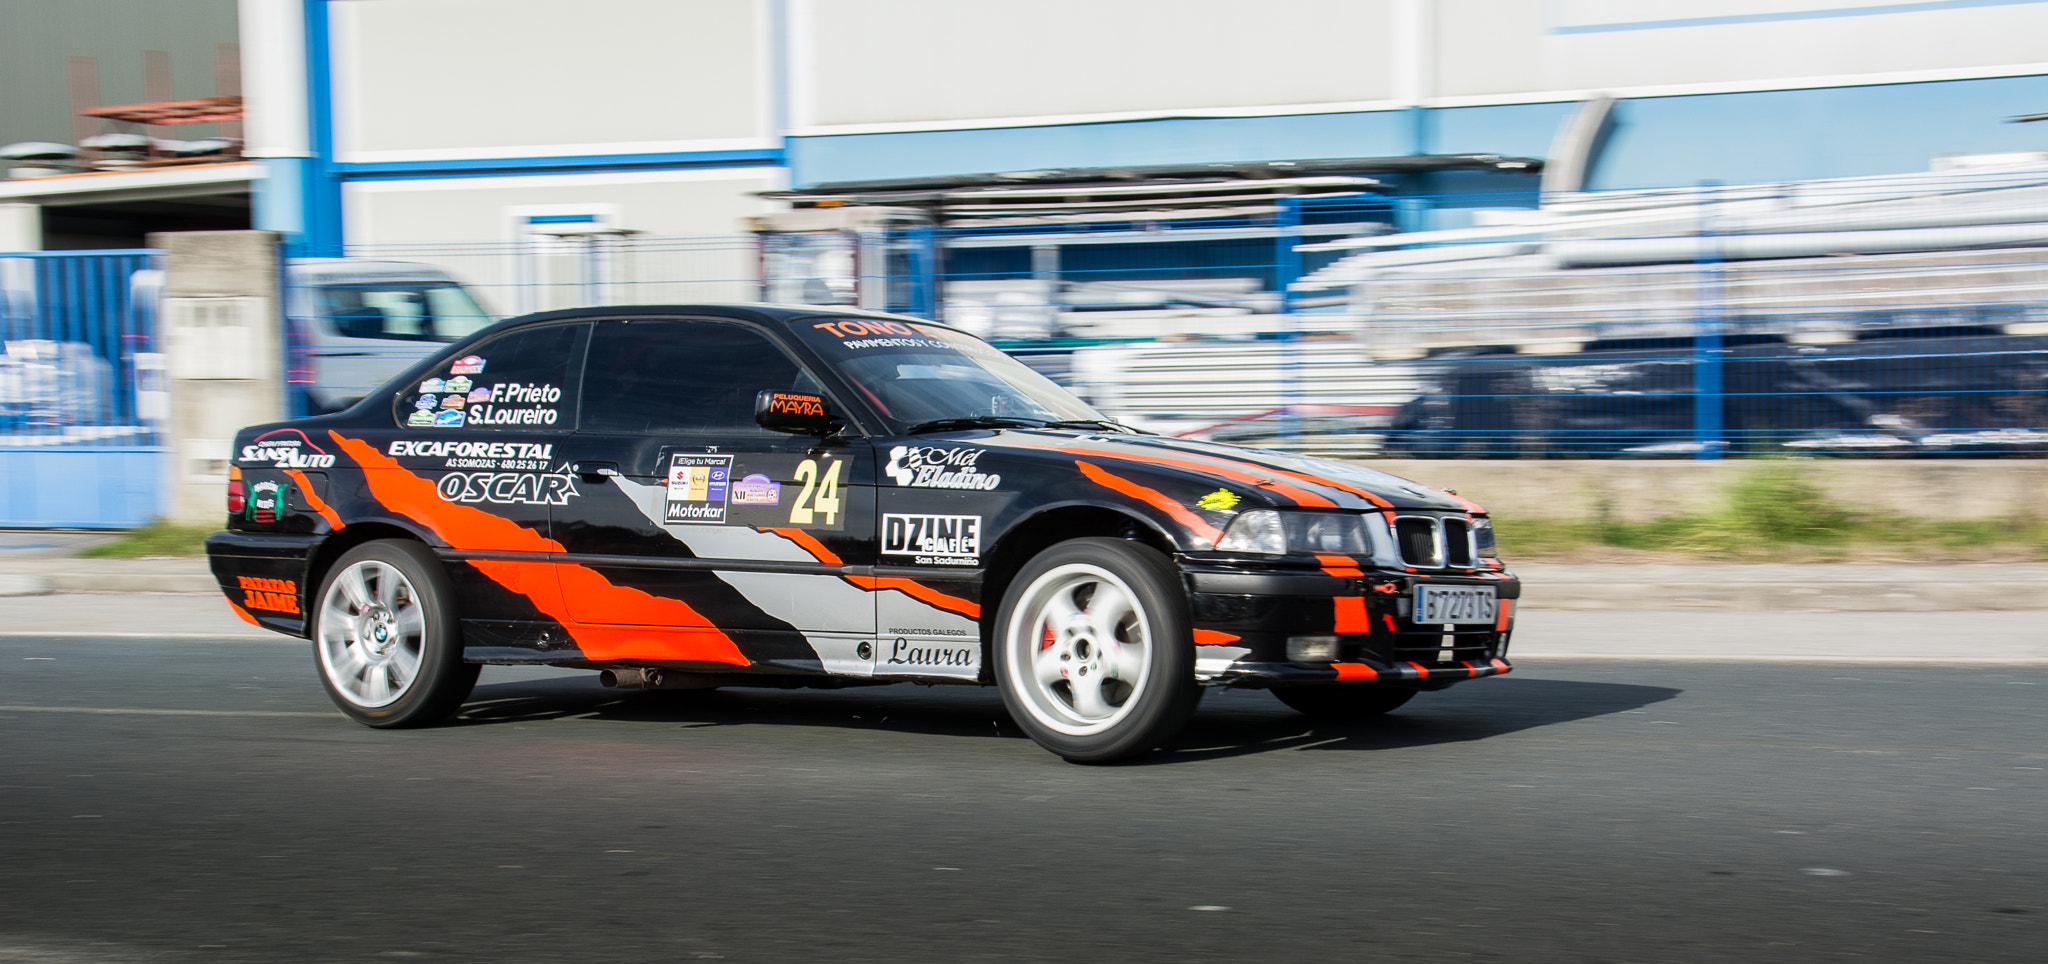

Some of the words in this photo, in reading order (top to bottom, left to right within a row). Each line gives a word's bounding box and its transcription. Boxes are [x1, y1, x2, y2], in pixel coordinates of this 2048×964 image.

[813, 320, 913, 338] TONO
[489, 383, 562, 403] F.Prieto
[773, 393, 822, 403] PELUQUERIA
[467, 404, 558, 425] S.Loureiro
[769, 399, 824, 417] MAYRA
[388, 440, 553, 460] EXCAFORESTAL
[926, 446, 986, 467] Mel
[445, 458, 457, 467] AS
[457, 458, 496, 468] SOMOZAS
[501, 459, 516, 469] 680
[516, 460, 527, 470] 25
[527, 460, 538, 470] 26
[538, 460, 549, 470] 17
[705, 458, 727, 466] Marca!
[912, 464, 1001, 491] Eladino
[437, 472, 570, 506] OSCAR
[789, 459, 843, 526] 24
[668, 502, 724, 519] Motorkar
[885, 516, 977, 554] DZINE
[924, 536, 971, 553] CAFÉ
[915, 555, 934, 565] San
[237, 576, 296, 594] PATATAS
[244, 589, 300, 614] JAIME
[887, 627, 932, 635] PRODUCTOS
[887, 637, 973, 667] Laura
